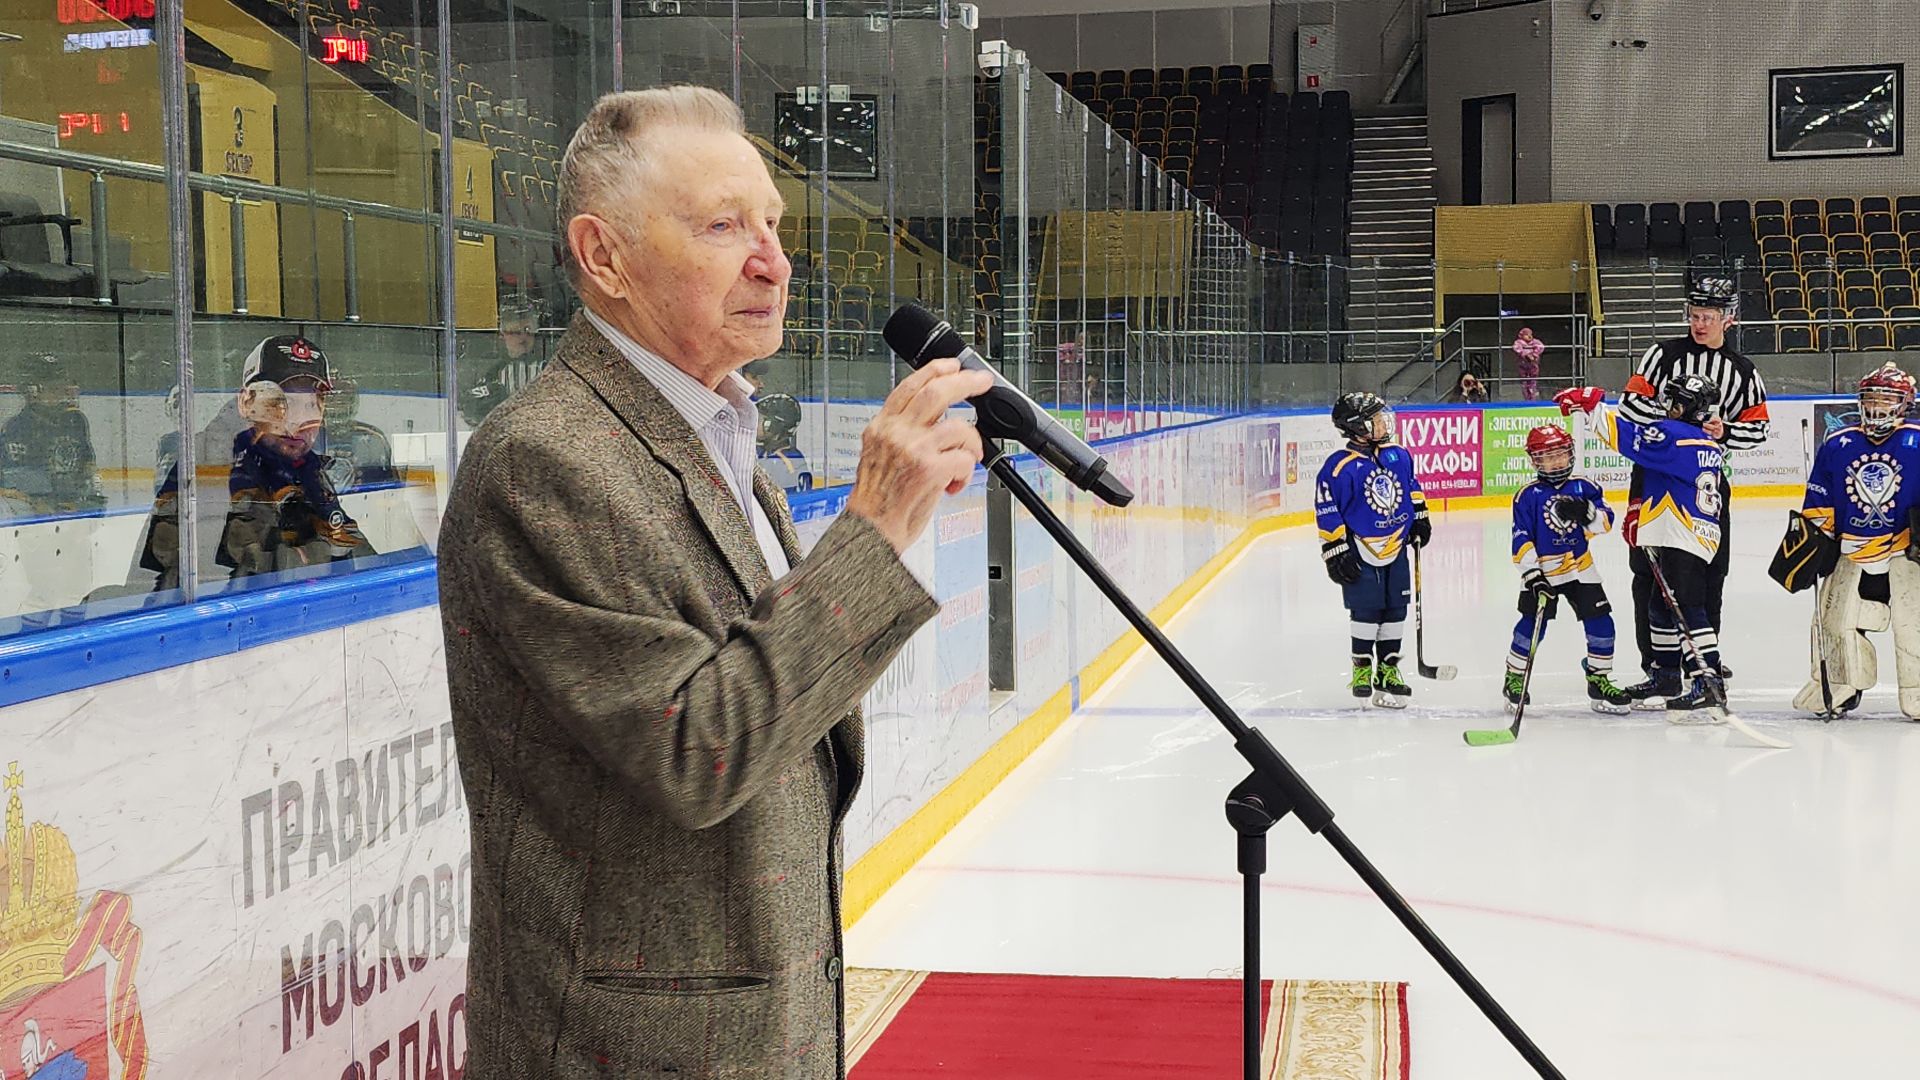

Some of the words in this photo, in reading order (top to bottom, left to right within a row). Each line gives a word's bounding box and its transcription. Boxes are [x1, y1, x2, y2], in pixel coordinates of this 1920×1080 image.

[1686, 377, 1704, 392] 82
[1401, 416, 1479, 448] КУХНИ
[1695, 471, 1721, 516] 8
[341, 993, 467, 1080] ЛАС
